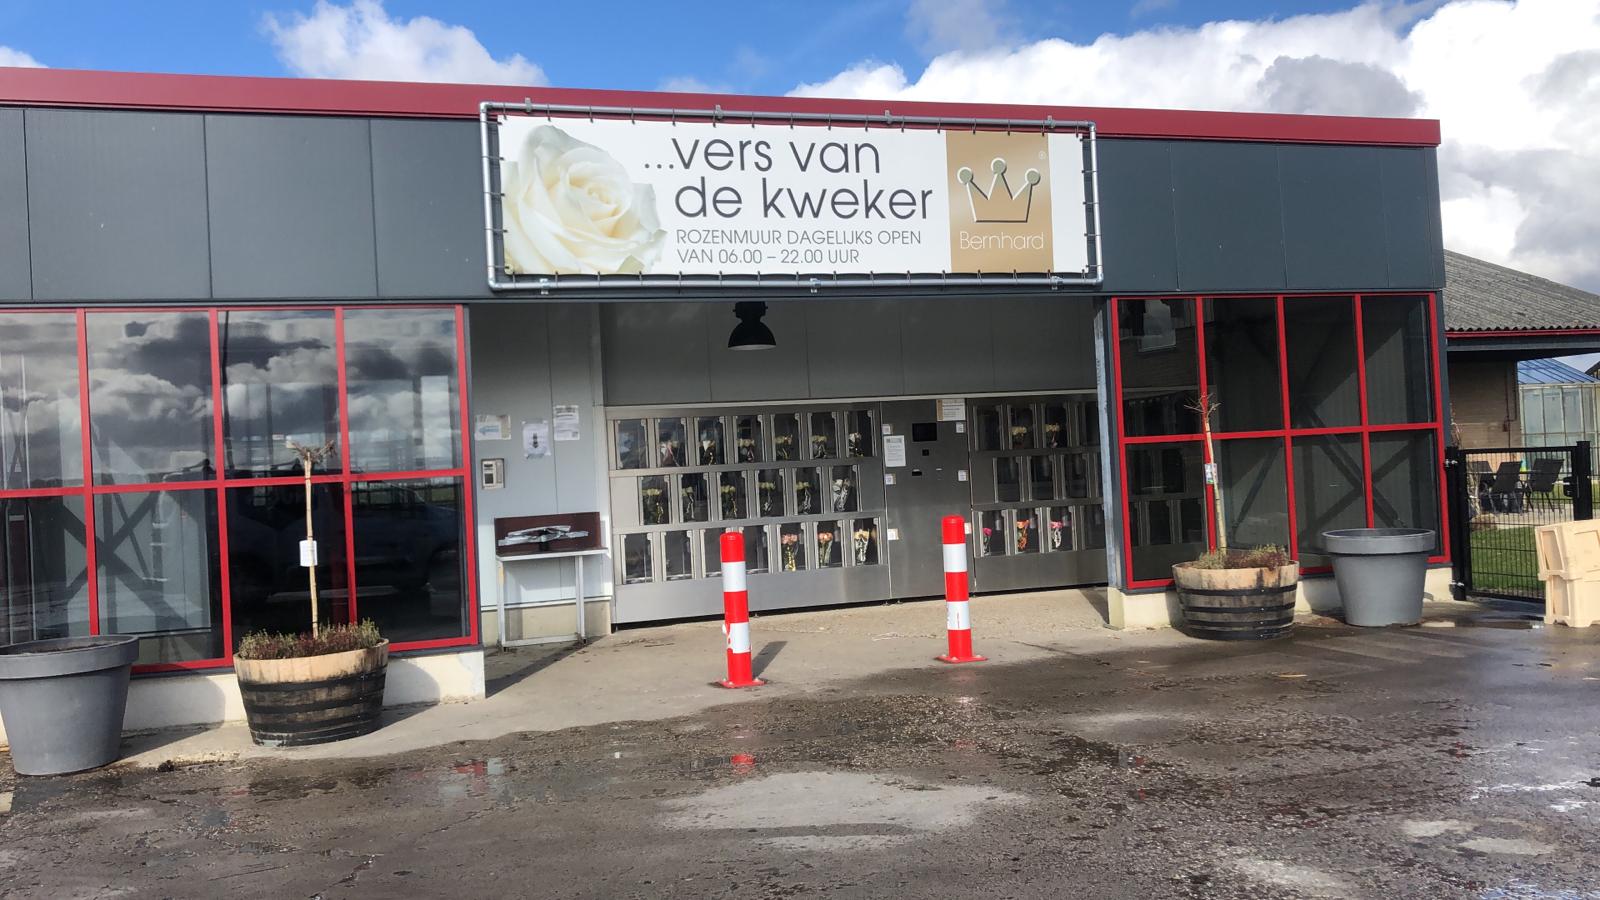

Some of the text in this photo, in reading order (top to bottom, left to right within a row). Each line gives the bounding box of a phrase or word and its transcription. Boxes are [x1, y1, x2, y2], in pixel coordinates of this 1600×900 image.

[644, 138, 880, 174] ...vers van
[674, 175, 933, 220] de kweker
[676, 229, 921, 245] ROZENMUUR DAGELIJKS OPEN
[959, 230, 1045, 250] Bernhard
[677, 248, 713, 263] VAN
[718, 248, 762, 264] 06.00
[780, 249, 823, 264] 22.00
[828, 249, 860, 264] UUR
